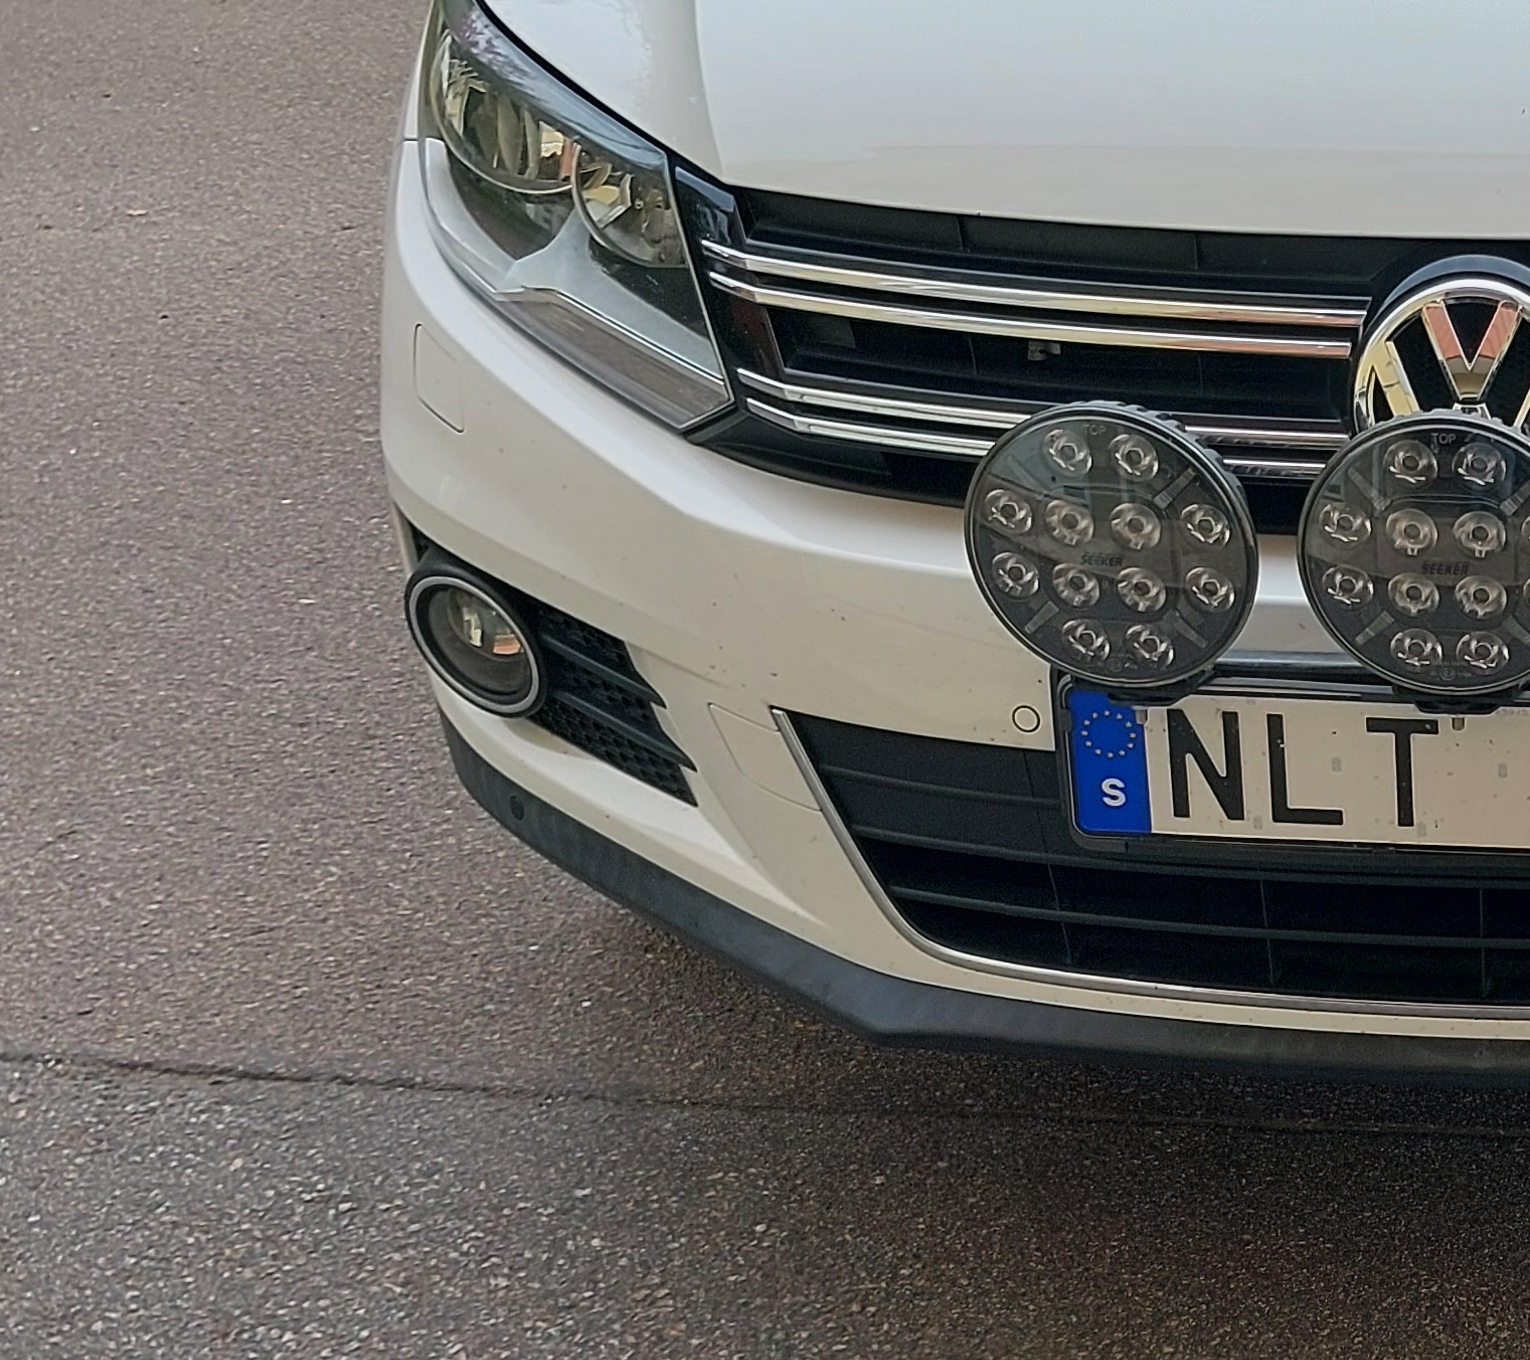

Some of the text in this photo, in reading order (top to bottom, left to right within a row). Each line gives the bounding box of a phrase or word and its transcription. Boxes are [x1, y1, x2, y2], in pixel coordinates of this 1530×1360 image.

[1431, 431, 1456, 445] TOP
[1166, 708, 1439, 828] NLT
[1101, 778, 1126, 807] S
